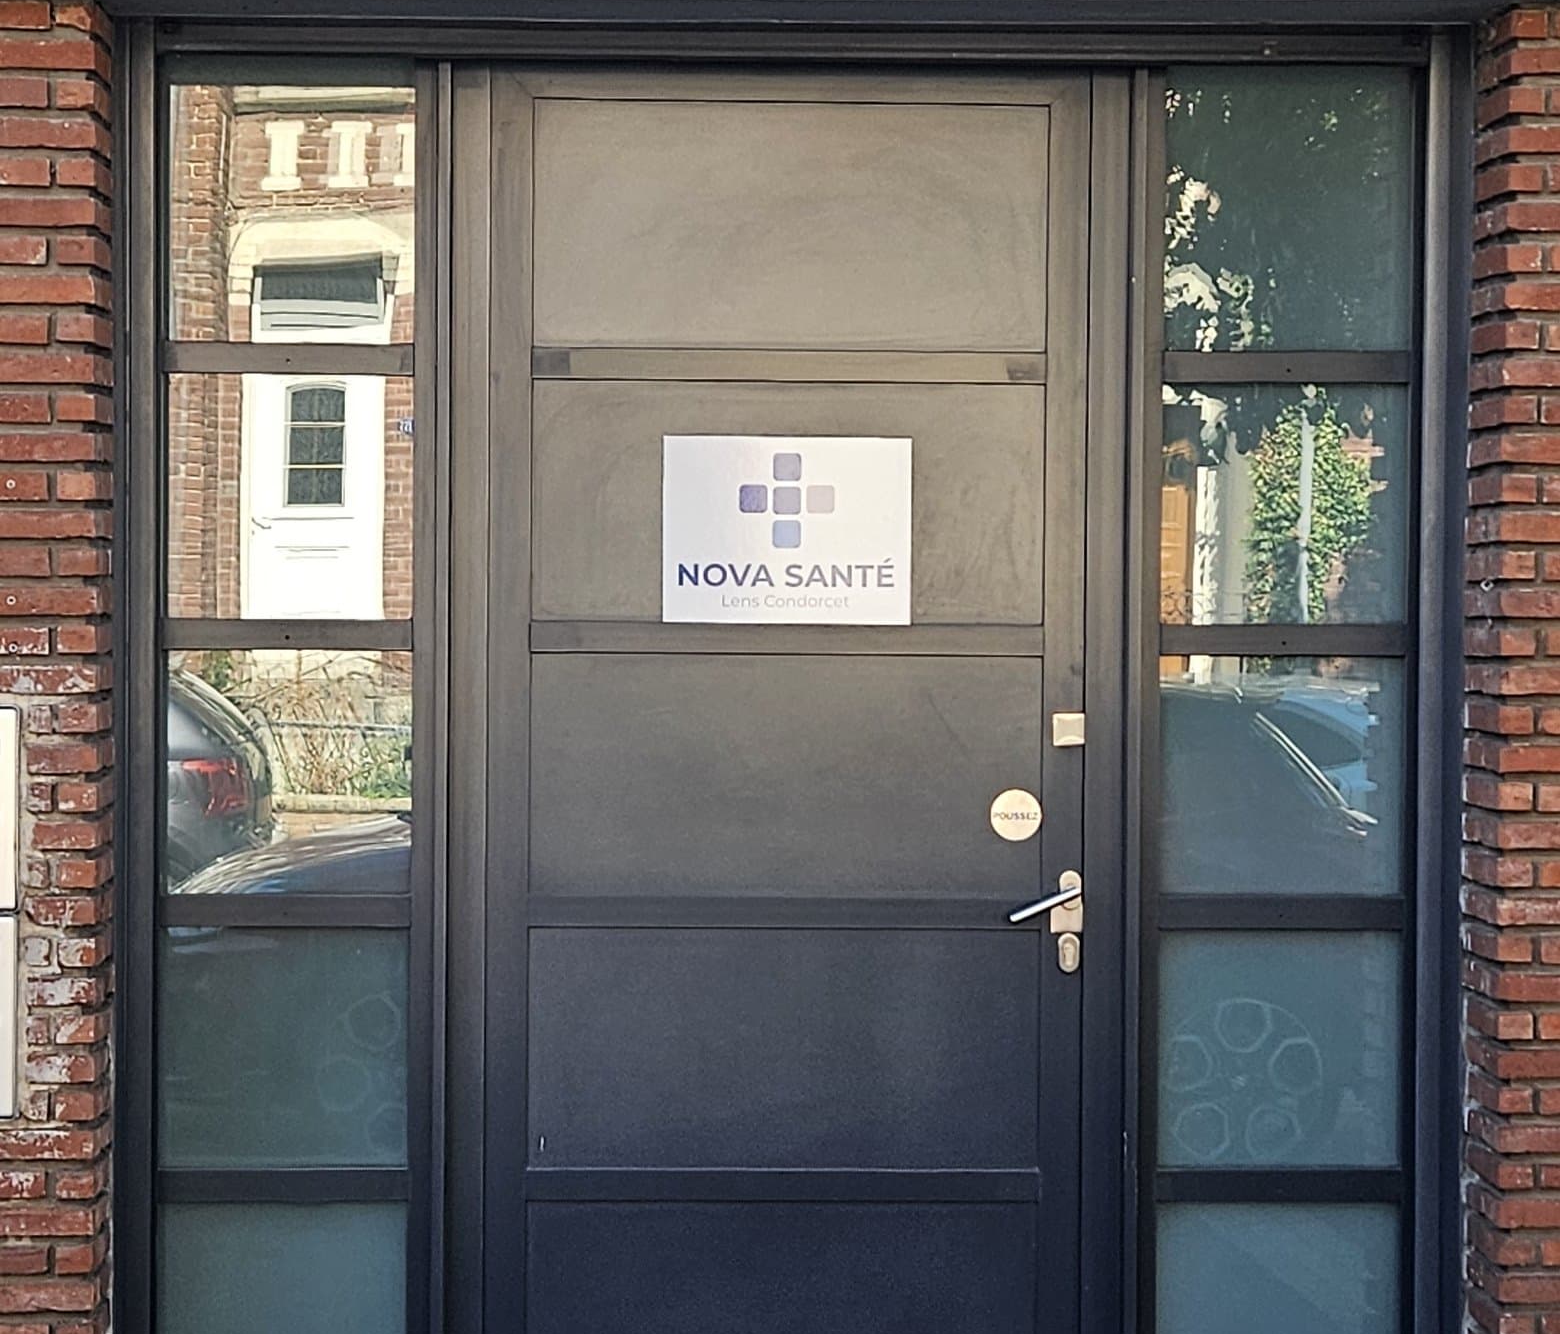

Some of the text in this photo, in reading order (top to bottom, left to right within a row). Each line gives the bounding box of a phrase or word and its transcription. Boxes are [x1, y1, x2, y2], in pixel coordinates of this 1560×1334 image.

[677, 557, 895, 588] NOVA SANTÉ
[721, 594, 850, 609] Lens Condorcet
[993, 811, 1038, 821] POUSSEZ
